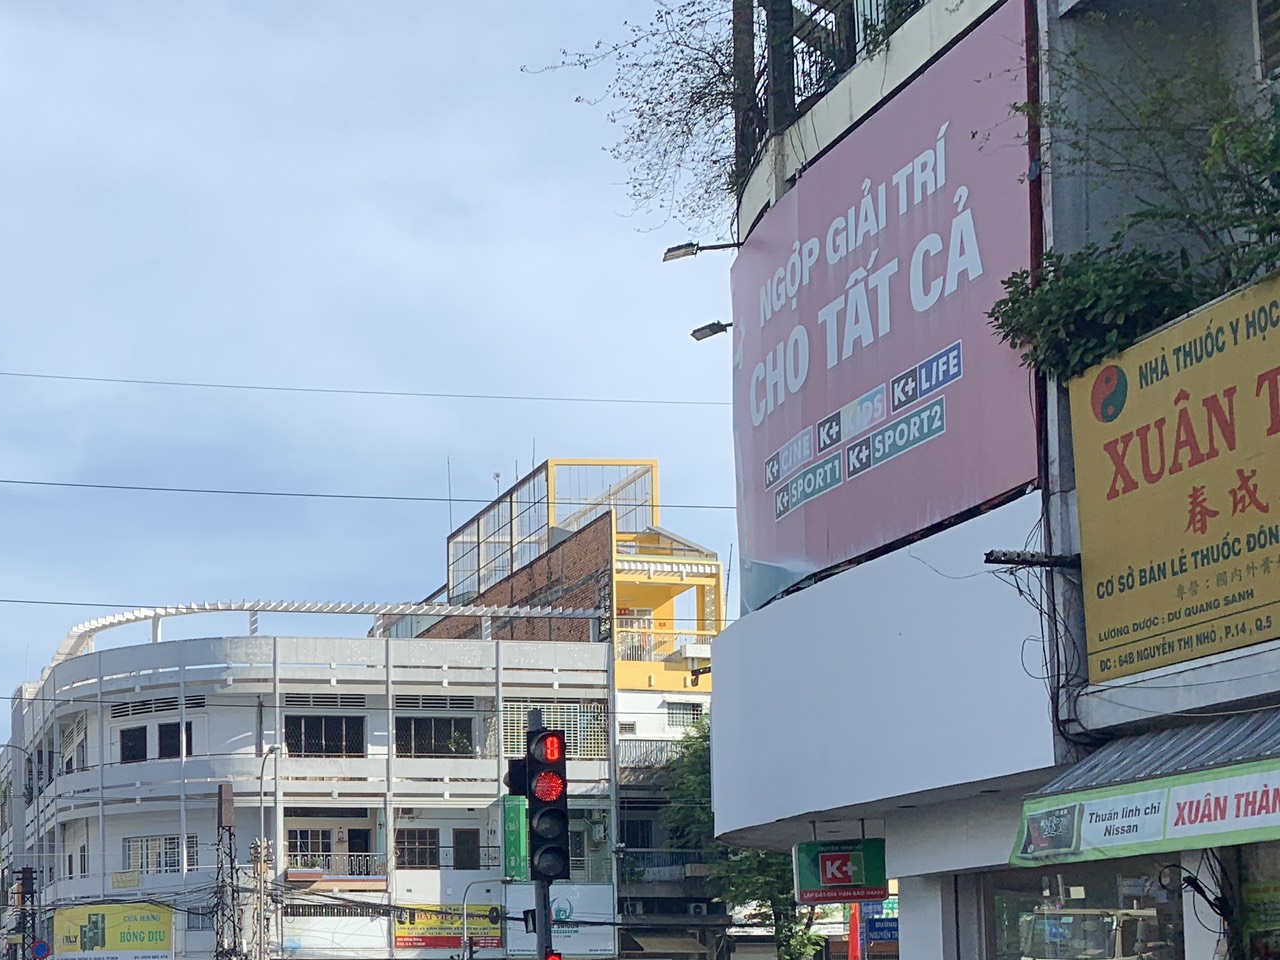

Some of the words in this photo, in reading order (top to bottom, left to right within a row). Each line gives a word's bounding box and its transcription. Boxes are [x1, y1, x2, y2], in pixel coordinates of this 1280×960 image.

[825, 177, 887, 265] GIẢI
[892, 120, 950, 216] TRÍ
[749, 324, 810, 427] CHO
[817, 247, 899, 371] TẤT
[909, 185, 984, 313] CẢ
[1138, 347, 1169, 389] NHÀ
[1173, 319, 1226, 372] THUỐC
[1229, 317, 1240, 346] Y
[1245, 299, 1280, 342] HỌC
[921, 349, 959, 391] LIFE
[791, 459, 840, 503] SPORT1
[874, 405, 942, 458] SPORT2
[1103, 385, 1237, 501] XUÂN
[1139, 560, 1167, 587] BÁN
[1191, 532, 1242, 569] THUỐC
[1184, 599, 1220, 617] QUANG
[1223, 588, 1255, 607] SANH
[1118, 652, 1134, 667] 64B
[1103, 823, 1138, 837] Nissan
[1121, 804, 1140, 819] linh
[1144, 801, 1161, 815] chi
[1174, 792, 1228, 827] XUÂN
[826, 860, 858, 879] K+
